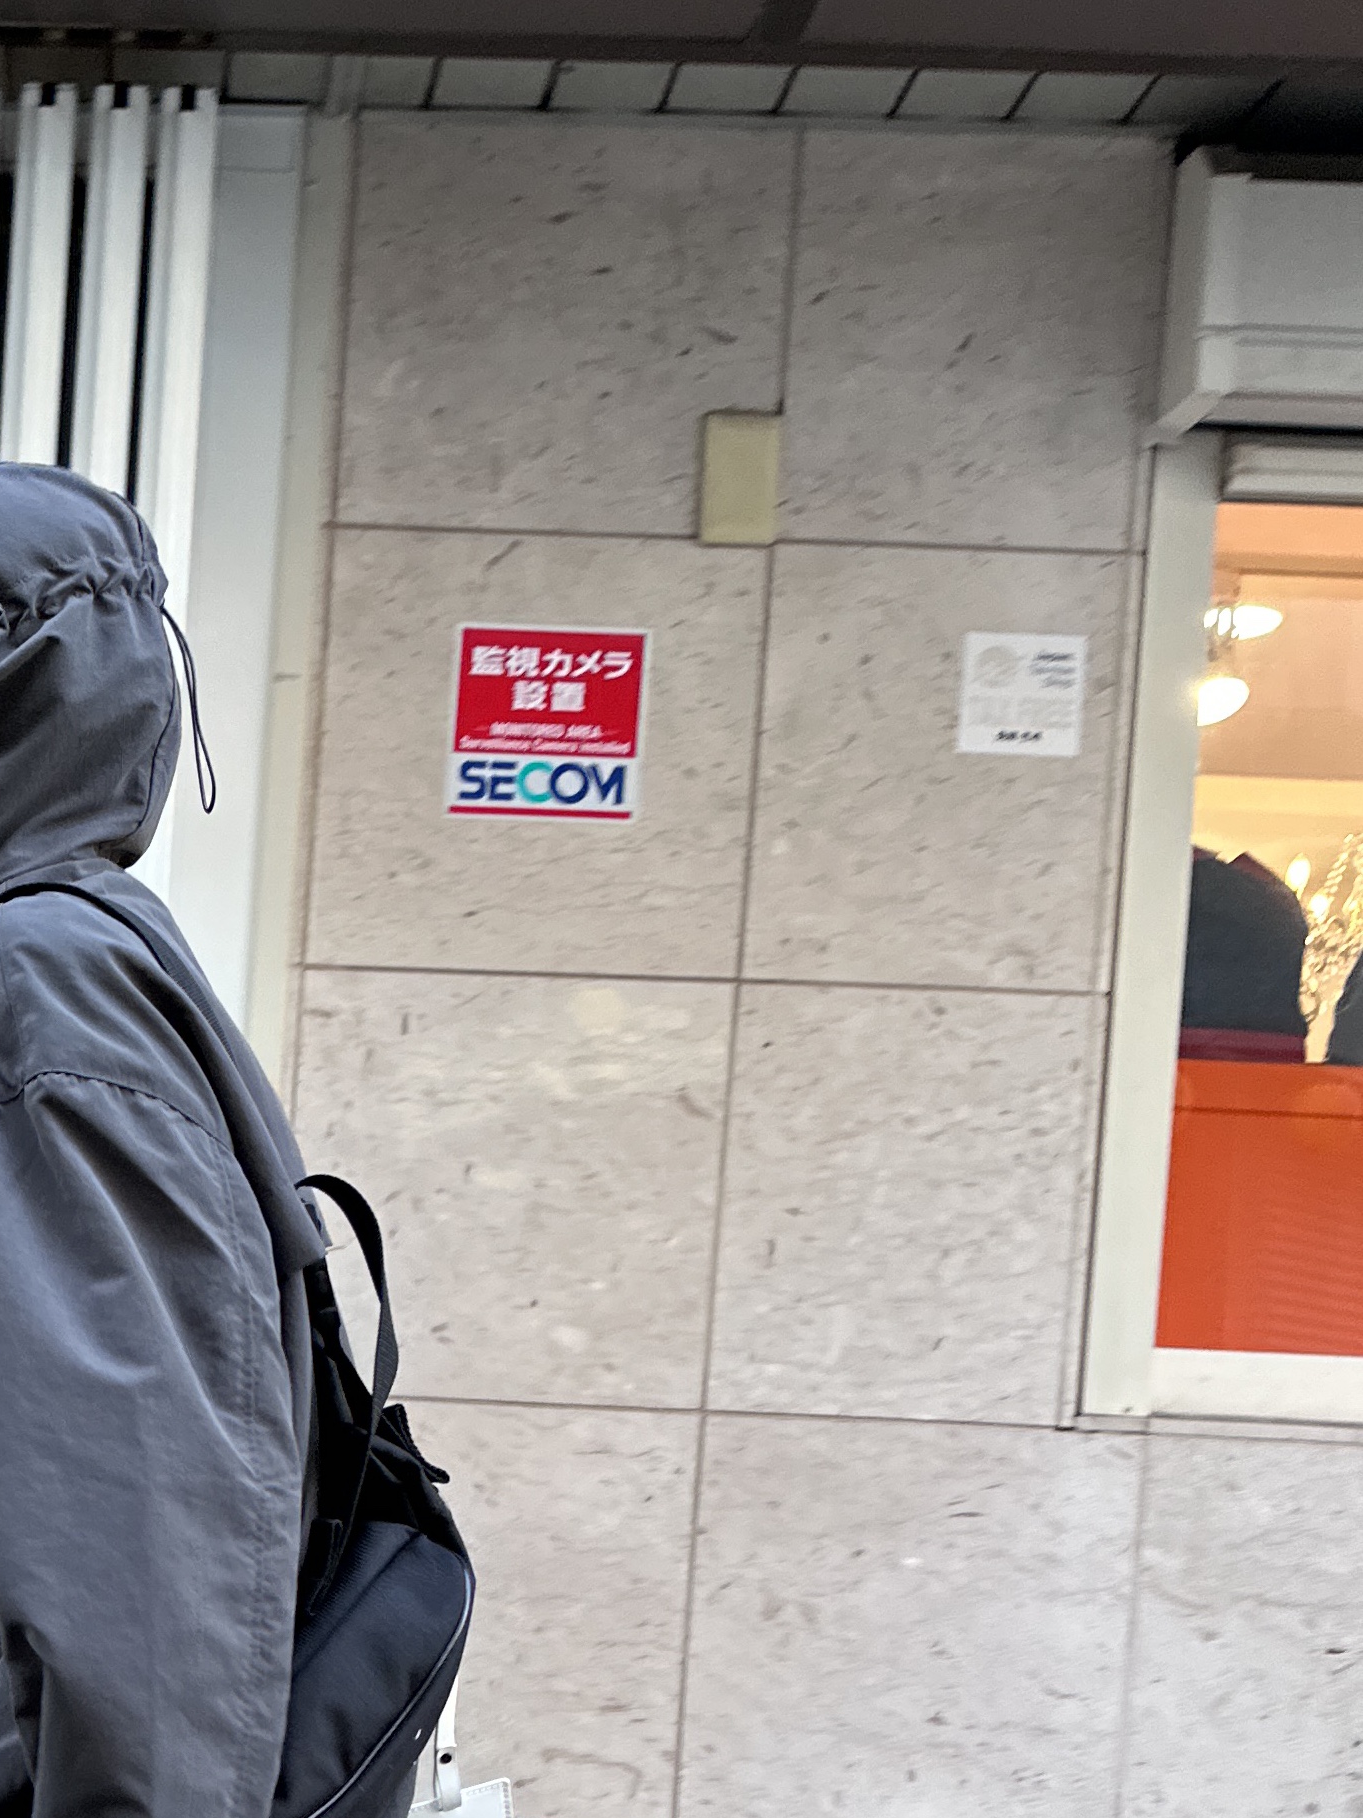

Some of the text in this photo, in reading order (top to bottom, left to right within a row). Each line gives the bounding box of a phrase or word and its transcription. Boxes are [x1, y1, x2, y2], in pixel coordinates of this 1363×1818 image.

[469, 645, 633, 680] 監視カメラ
[511, 680, 587, 712] 設置
[458, 760, 627, 805] SECOM
